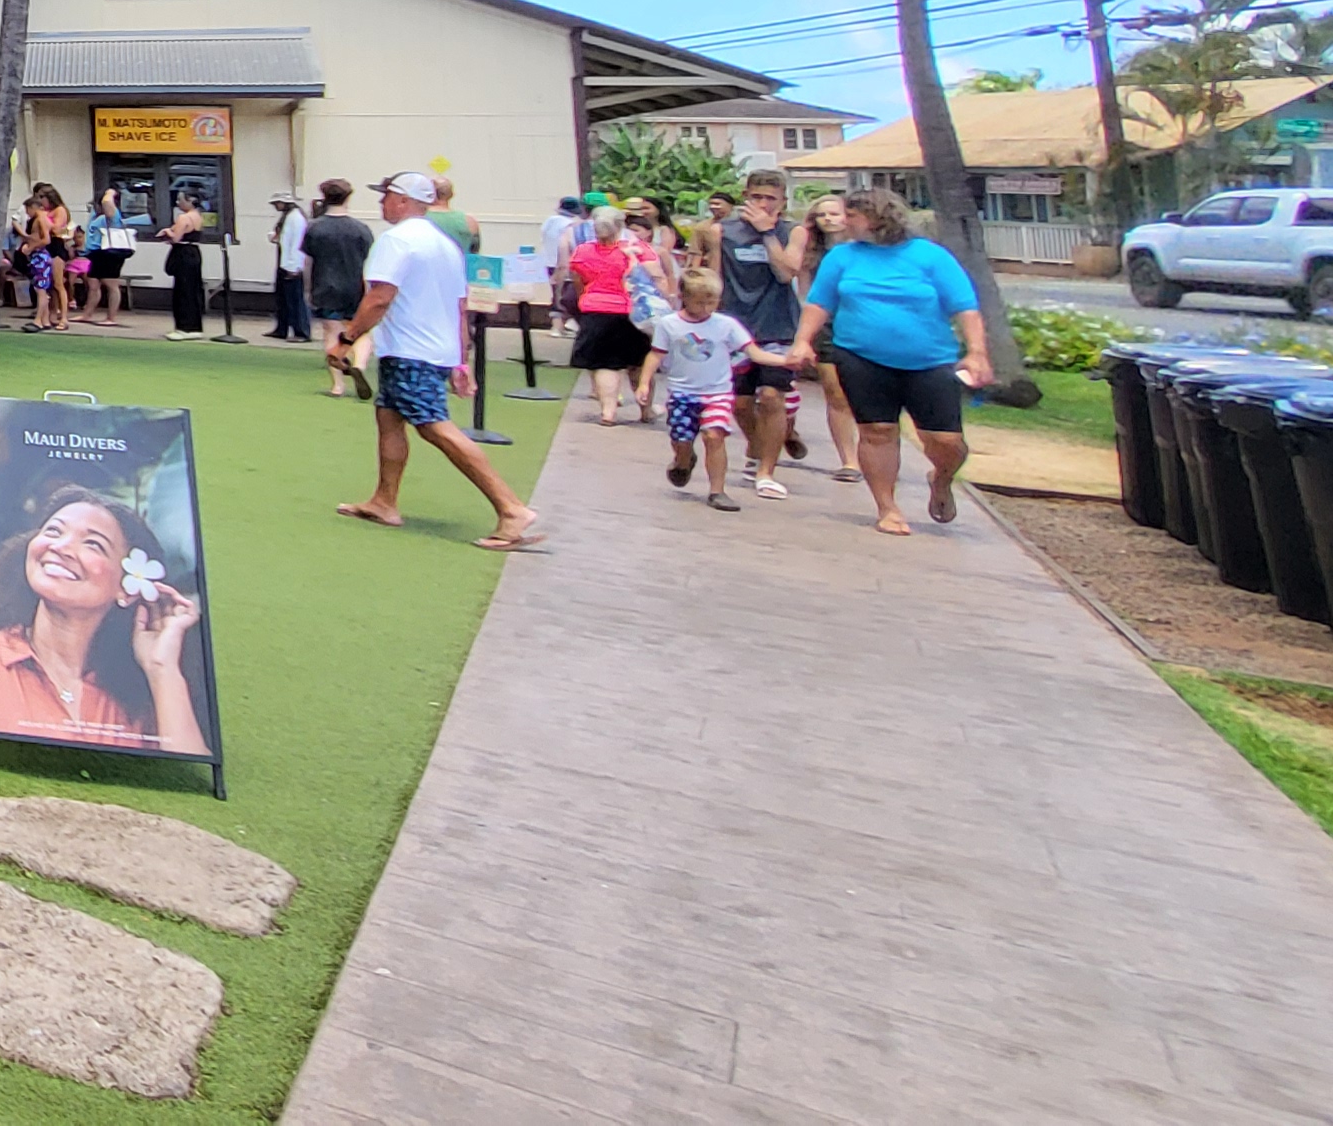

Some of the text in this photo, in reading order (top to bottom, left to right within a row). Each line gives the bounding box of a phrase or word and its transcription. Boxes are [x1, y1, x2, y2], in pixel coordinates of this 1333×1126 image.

[113, 118, 187, 128] MATSUMOTO
[108, 131, 177, 142] SHAVE ICE
[24, 430, 128, 451] MAUI DIVERS
[48, 450, 104, 461] JEWELRY
